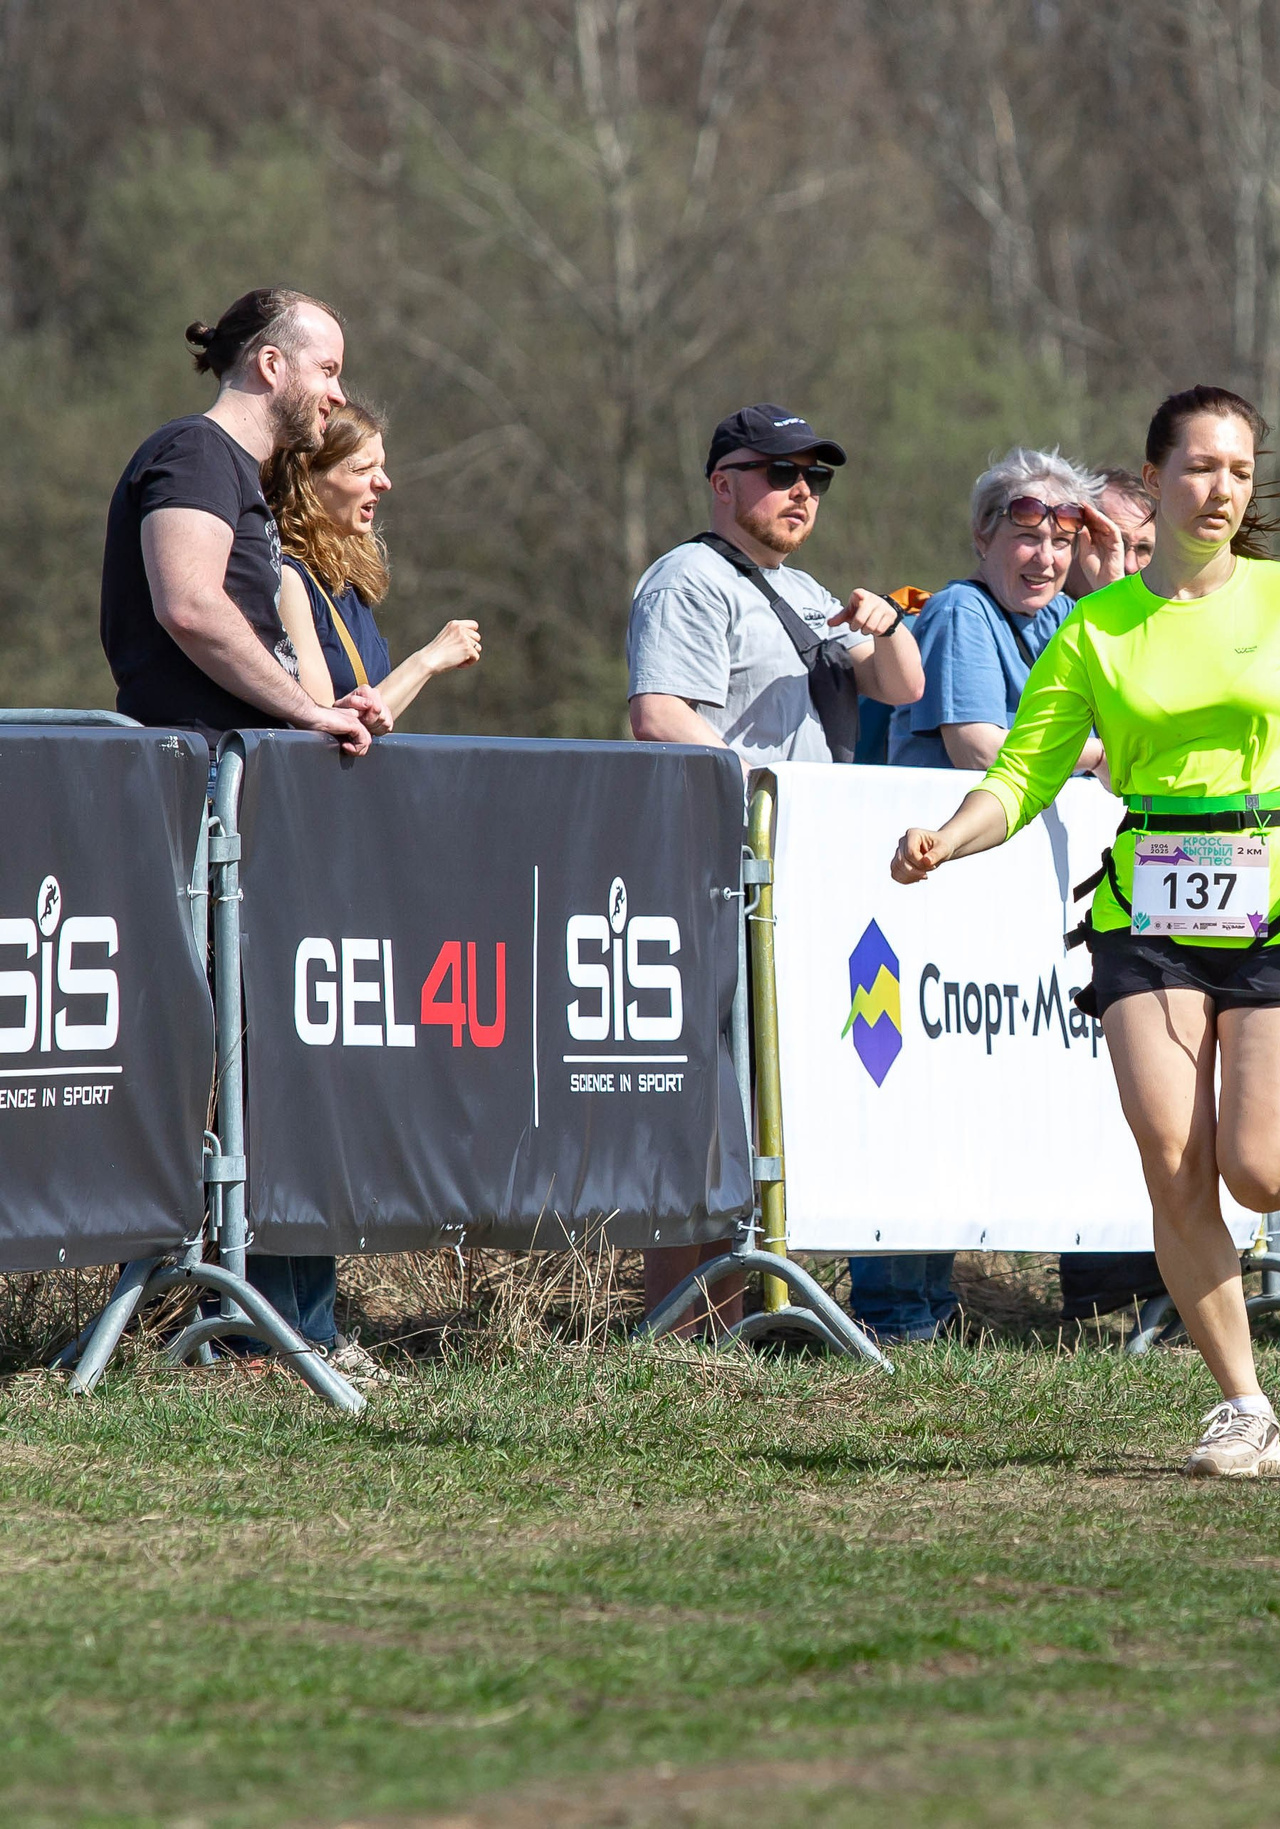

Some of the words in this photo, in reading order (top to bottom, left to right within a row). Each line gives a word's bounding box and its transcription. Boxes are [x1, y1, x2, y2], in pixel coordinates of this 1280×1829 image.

[1162, 872, 1237, 910] 137
[570, 1073, 615, 1092] SCIENCE
[619, 1073, 632, 1092] IN
[638, 1073, 685, 1092] SPORT
[42, 1087, 56, 1107] IN
[63, 1085, 114, 1106] SPORT
